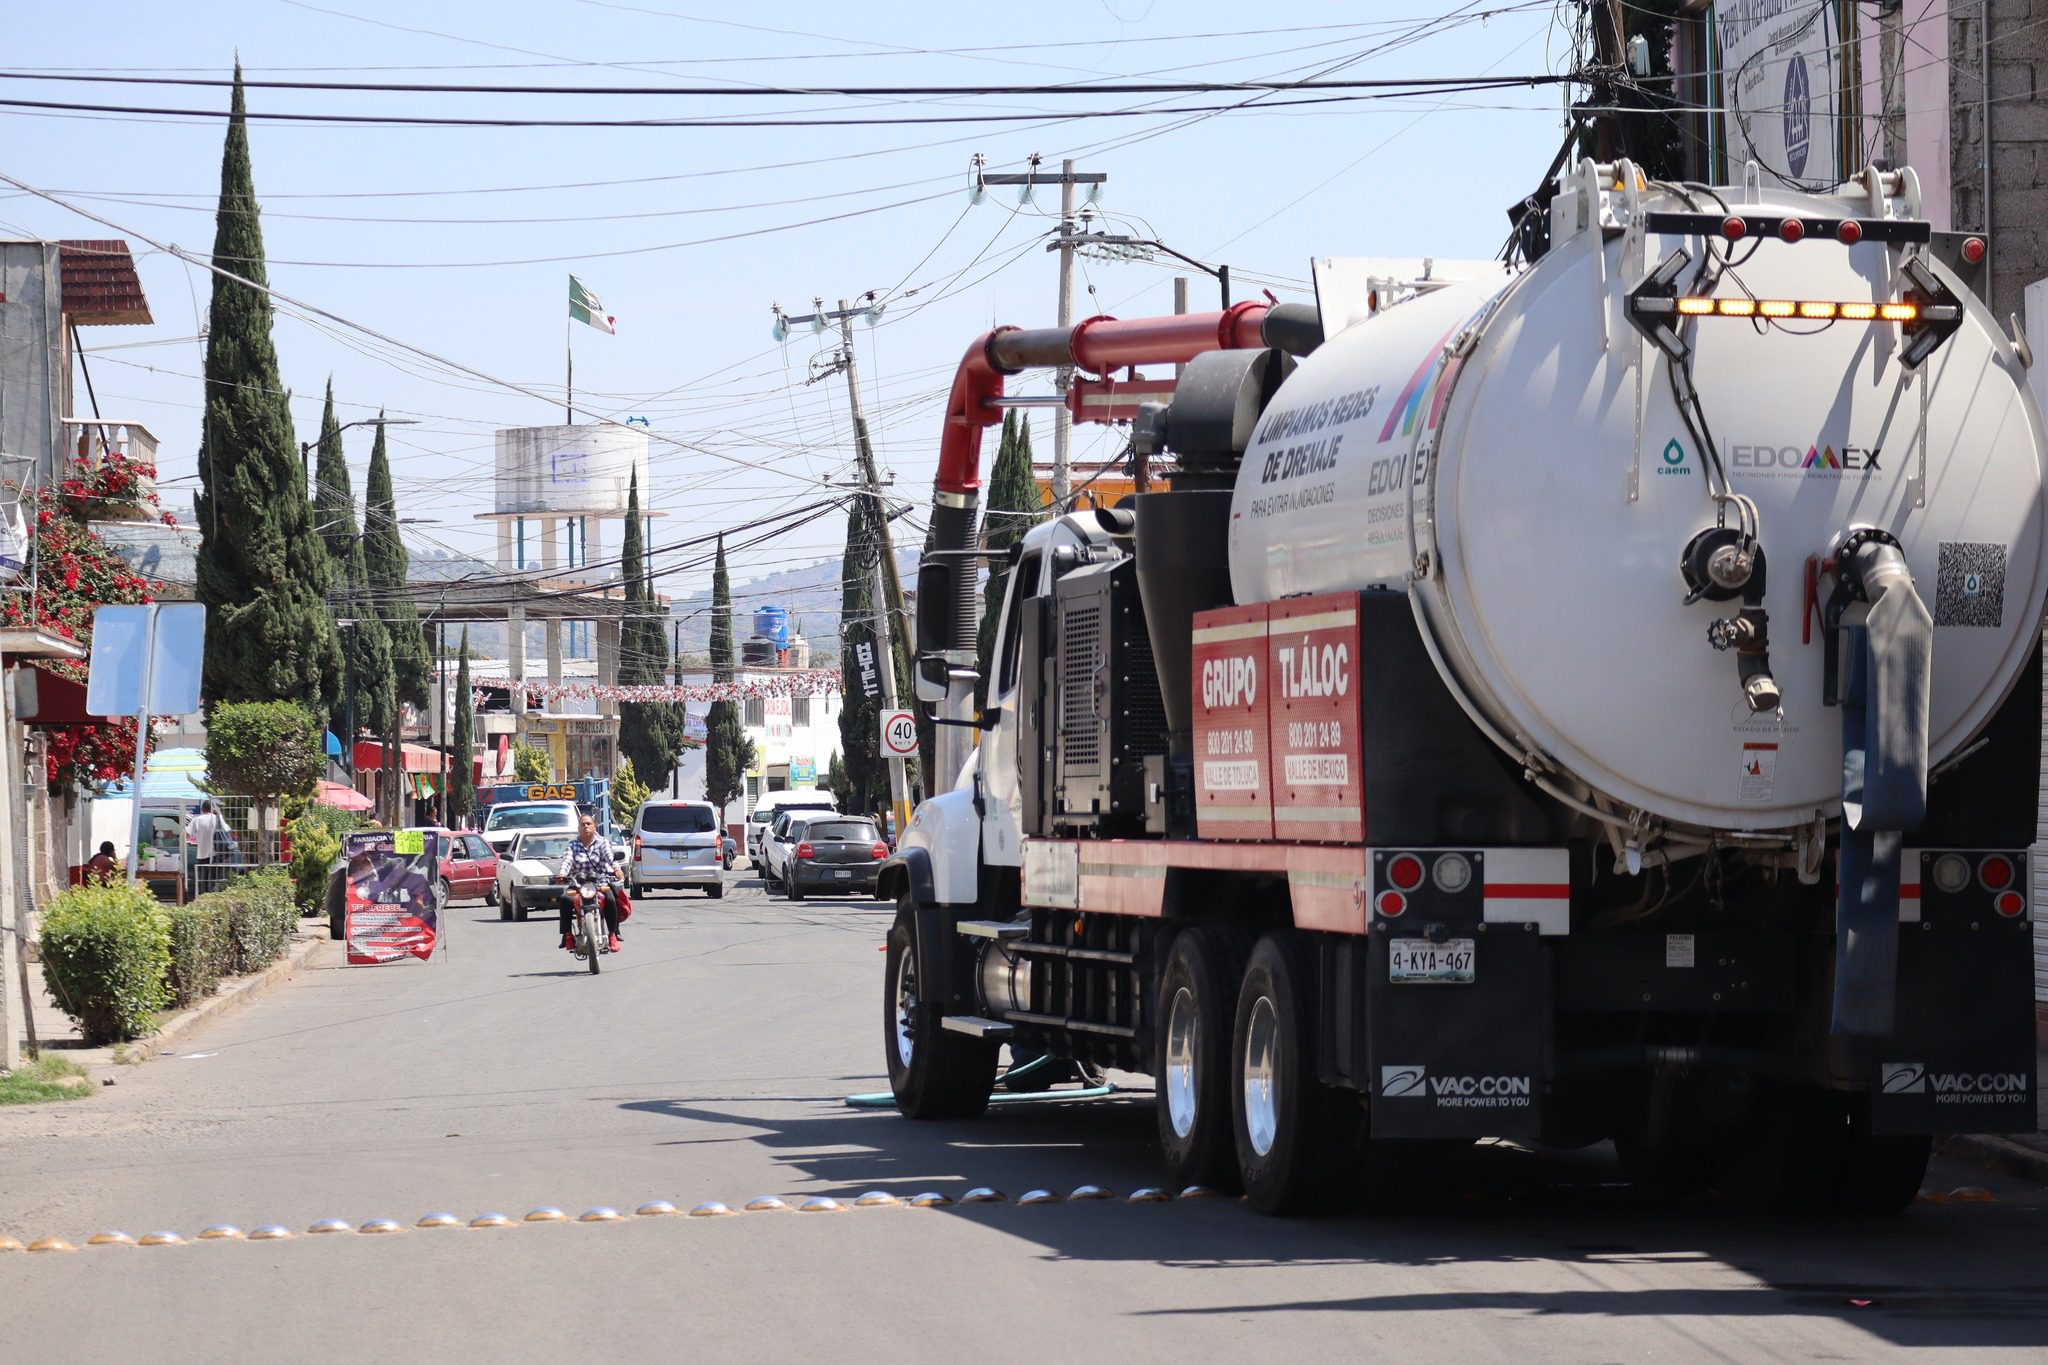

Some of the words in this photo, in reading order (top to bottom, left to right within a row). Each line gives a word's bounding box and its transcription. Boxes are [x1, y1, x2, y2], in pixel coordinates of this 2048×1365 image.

[1257, 398, 1335, 446] LIMPIAMOS
[1327, 384, 1380, 428] REDES
[1261, 450, 1284, 484] DE
[1280, 434, 1344, 481] DRENAJE
[1656, 466, 1691, 476] caem
[1732, 471, 1776, 479] DECISIONES
[1250, 499, 1267, 519] PARA
[1267, 493, 1289, 517] EVITAR
[1288, 482, 1335, 512] INUNDACIONES
[856, 641, 878, 690] HOTEL
[1202, 655, 1257, 710] GRUPO
[1279, 635, 1348, 698] TLÁLOC
[893, 722, 912, 739] 40
[1288, 722, 1303, 748] 800
[1303, 722, 1318, 747] 201
[1319, 721, 1330, 747] 24
[1330, 720, 1341, 747] 89
[1773, 725, 1799, 733] MXICO
[1286, 760, 1308, 781] VALLE
[1307, 760, 1318, 780] DE
[527, 785, 576, 800] GAS
[1393, 951, 1472, 971] 4-KYA-467
[1437, 1097, 1464, 1107] MORE
[1463, 1097, 1497, 1107] POWER
[1498, 1097, 1510, 1107] TO
[1510, 1097, 1530, 1107] YOU
[1936, 1094, 1961, 1104] MORE
[1962, 1094, 1994, 1104] POWER
[1995, 1094, 2006, 1104] TO
[2006, 1094, 2026, 1104] YOU
